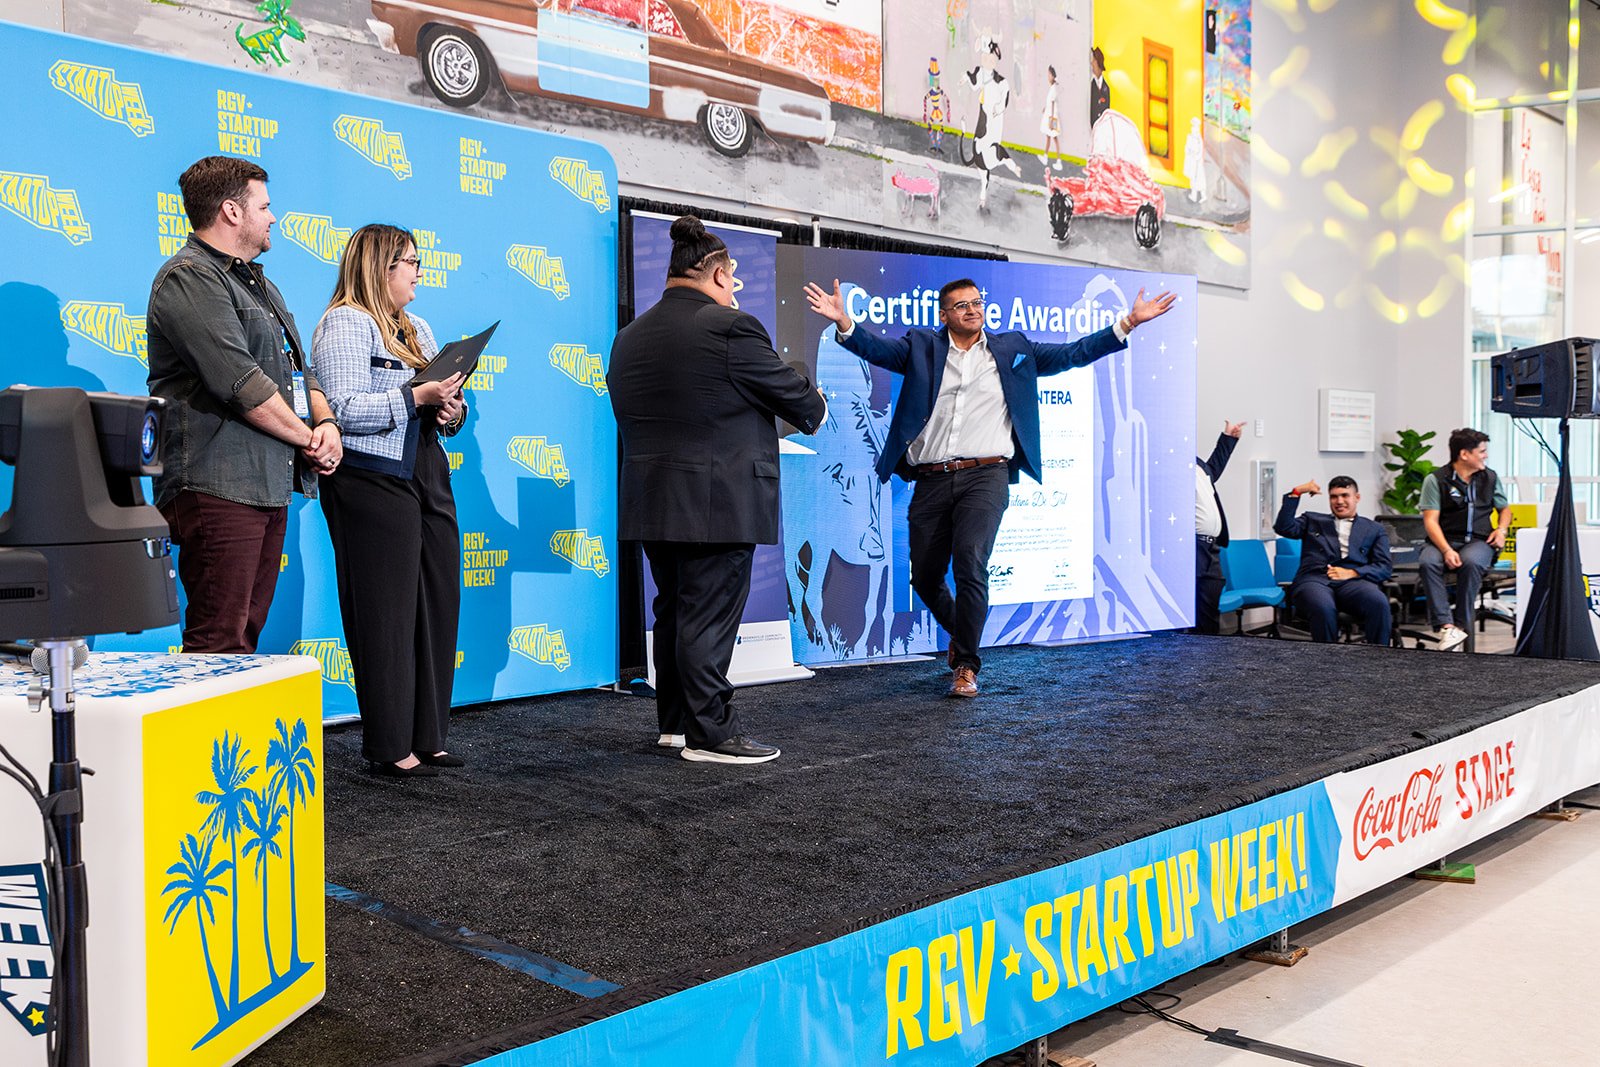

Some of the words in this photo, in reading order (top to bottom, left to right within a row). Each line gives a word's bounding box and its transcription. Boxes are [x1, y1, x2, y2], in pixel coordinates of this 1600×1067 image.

[54, 63, 124, 119] STARTUP
[121, 86, 152, 129] WEEK
[217, 89, 246, 113] RGV
[217, 110, 279, 139] STARTUP
[217, 131, 261, 158] WEEK!
[337, 117, 389, 165] STARTUP
[388, 135, 410, 173] WEEK
[459, 136, 482, 158] RGV
[459, 155, 507, 180] STARTUP
[552, 159, 593, 200] STARTUP
[459, 174, 493, 197] WEEK!
[0, 174, 59, 228] TARTUP
[55, 193, 89, 237] WEEK
[284, 215, 339, 262] STARTUP
[412, 228, 436, 249] RGV
[509, 247, 551, 287] STARTUP
[846, 286, 1002, 330] Certifie
[65, 304, 133, 353] STARTUP
[552, 346, 591, 384] STARTUP
[1038, 390, 1073, 405] NTERA
[510, 438, 551, 475] STARTUP
[463, 532, 485, 550] RGV
[553, 532, 592, 567] STARTUP
[463, 550, 509, 568] STARTUP
[463, 568, 495, 587] WEEK!
[511, 627, 553, 662] STARTUP
[1353, 762, 1446, 861] Coca-Cola
[1455, 740, 1516, 820] STAGE
[886, 919, 996, 1059] RGV
[1023, 848, 1200, 1002] STARTUP
[1209, 811, 1308, 924] WEEK!
